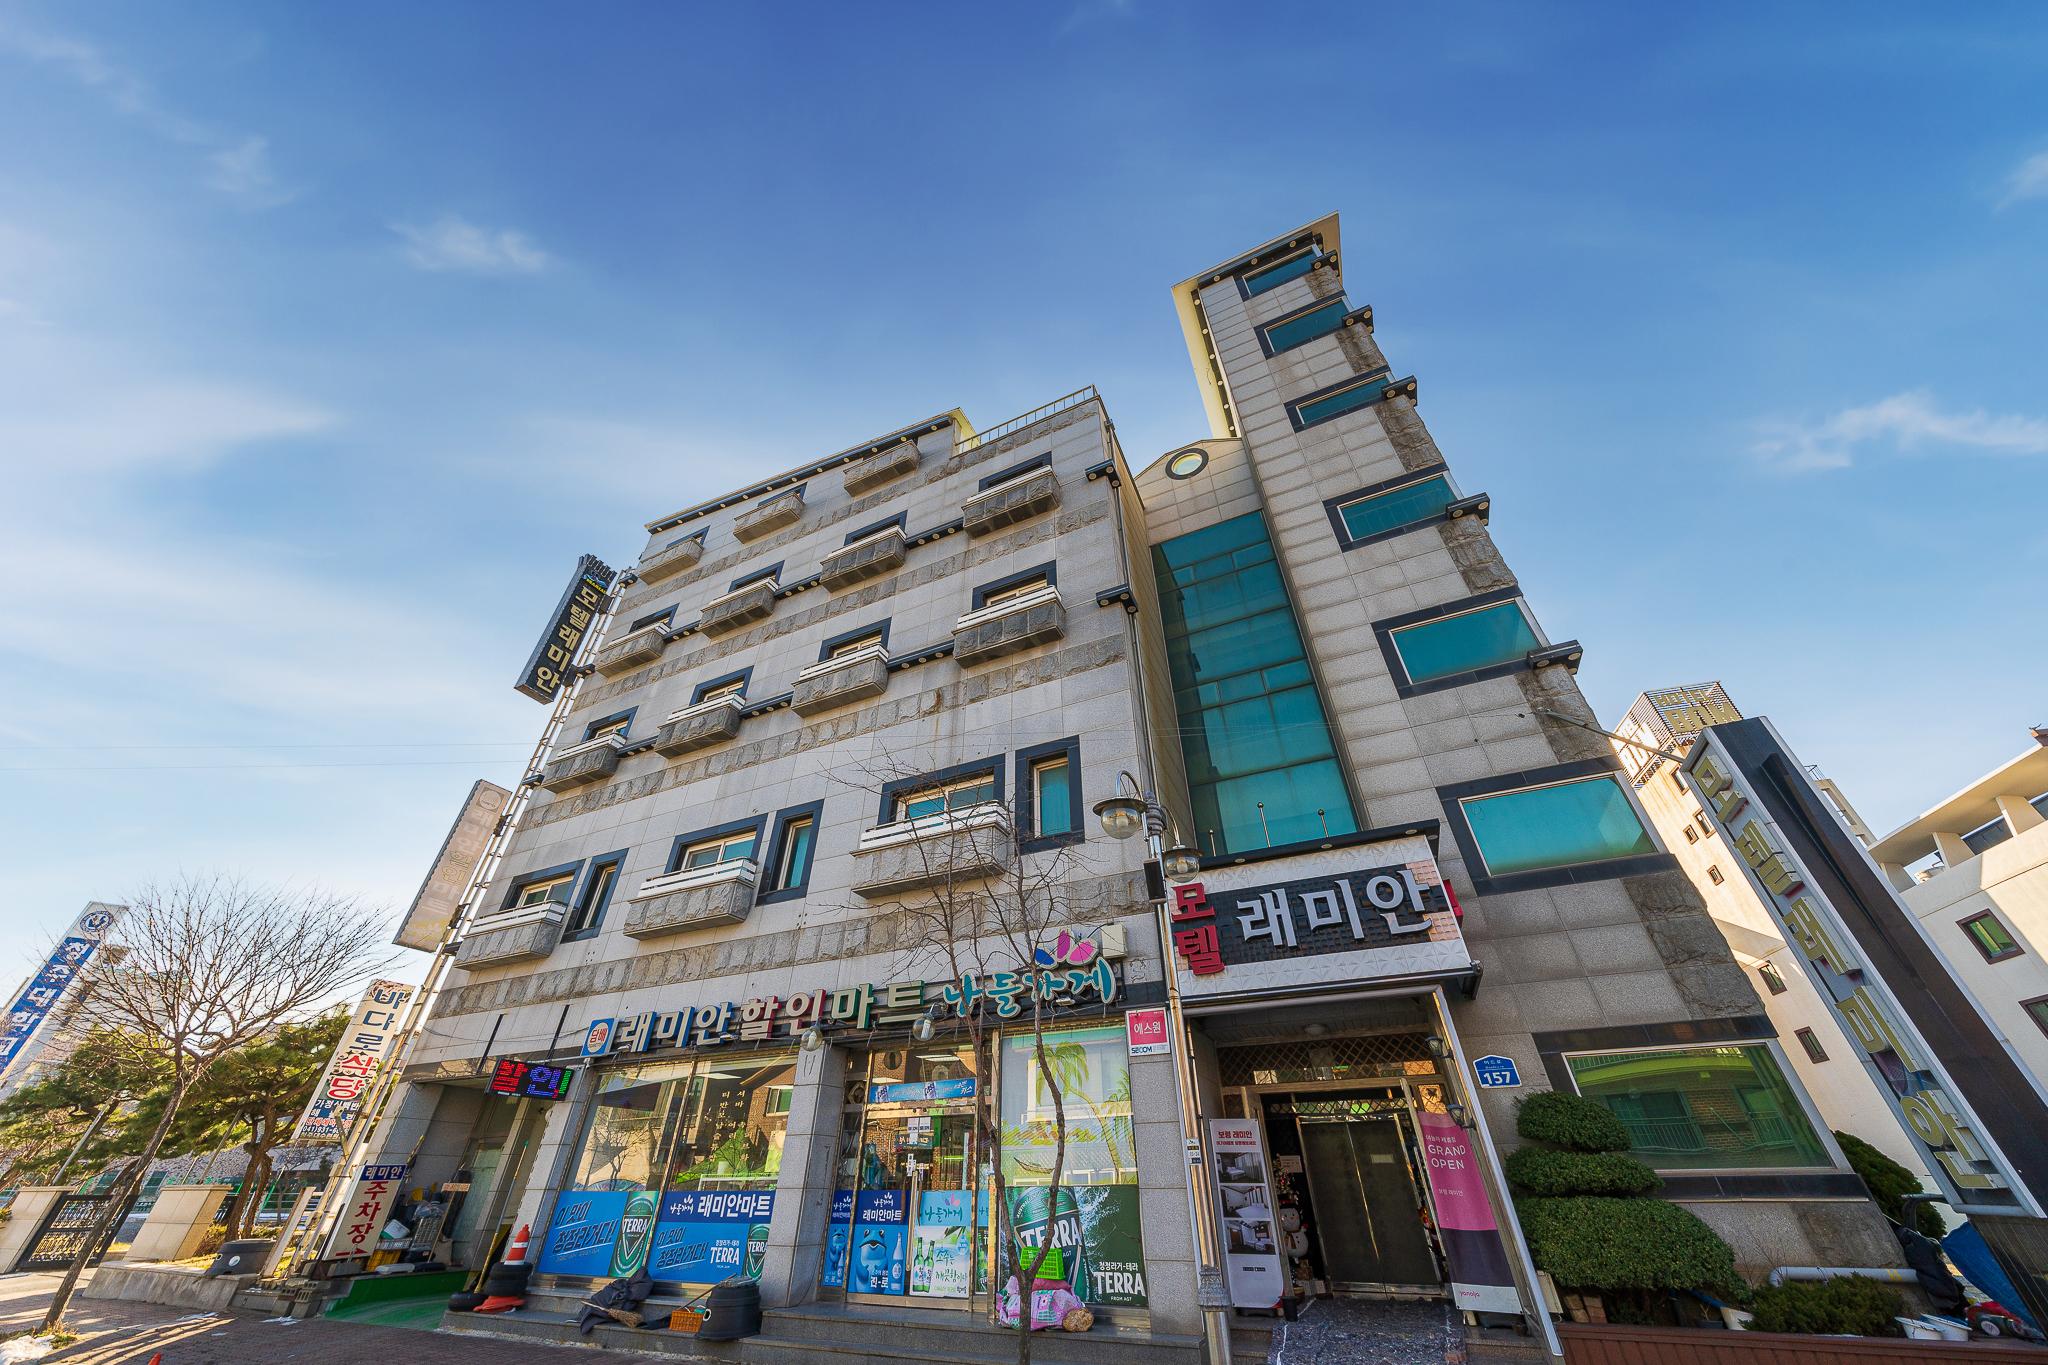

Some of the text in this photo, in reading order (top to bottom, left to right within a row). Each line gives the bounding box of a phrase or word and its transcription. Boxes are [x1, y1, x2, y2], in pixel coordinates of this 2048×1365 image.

[1236, 869, 1433, 948] 래미안
[1171, 882, 1225, 975] 모텔
[942, 958, 1117, 1019] 나들가게
[1133, 1021, 1161, 1035] 에스원
[1483, 1071, 1511, 1084] 157
[1428, 1144, 1466, 1156] GRAND
[1431, 1157, 1465, 1170] OPEN
[365, 1167, 402, 1180] 래미안
[347, 1181, 389, 1245] 주차장
[697, 1194, 771, 1218] 래미안마트
[925, 1206, 963, 1223] 나들가게
[863, 1209, 902, 1222] 래미안마트
[623, 1217, 648, 1234] TERRA
[710, 1247, 740, 1266] TERRA
[1093, 1271, 1147, 1297] TERRA
